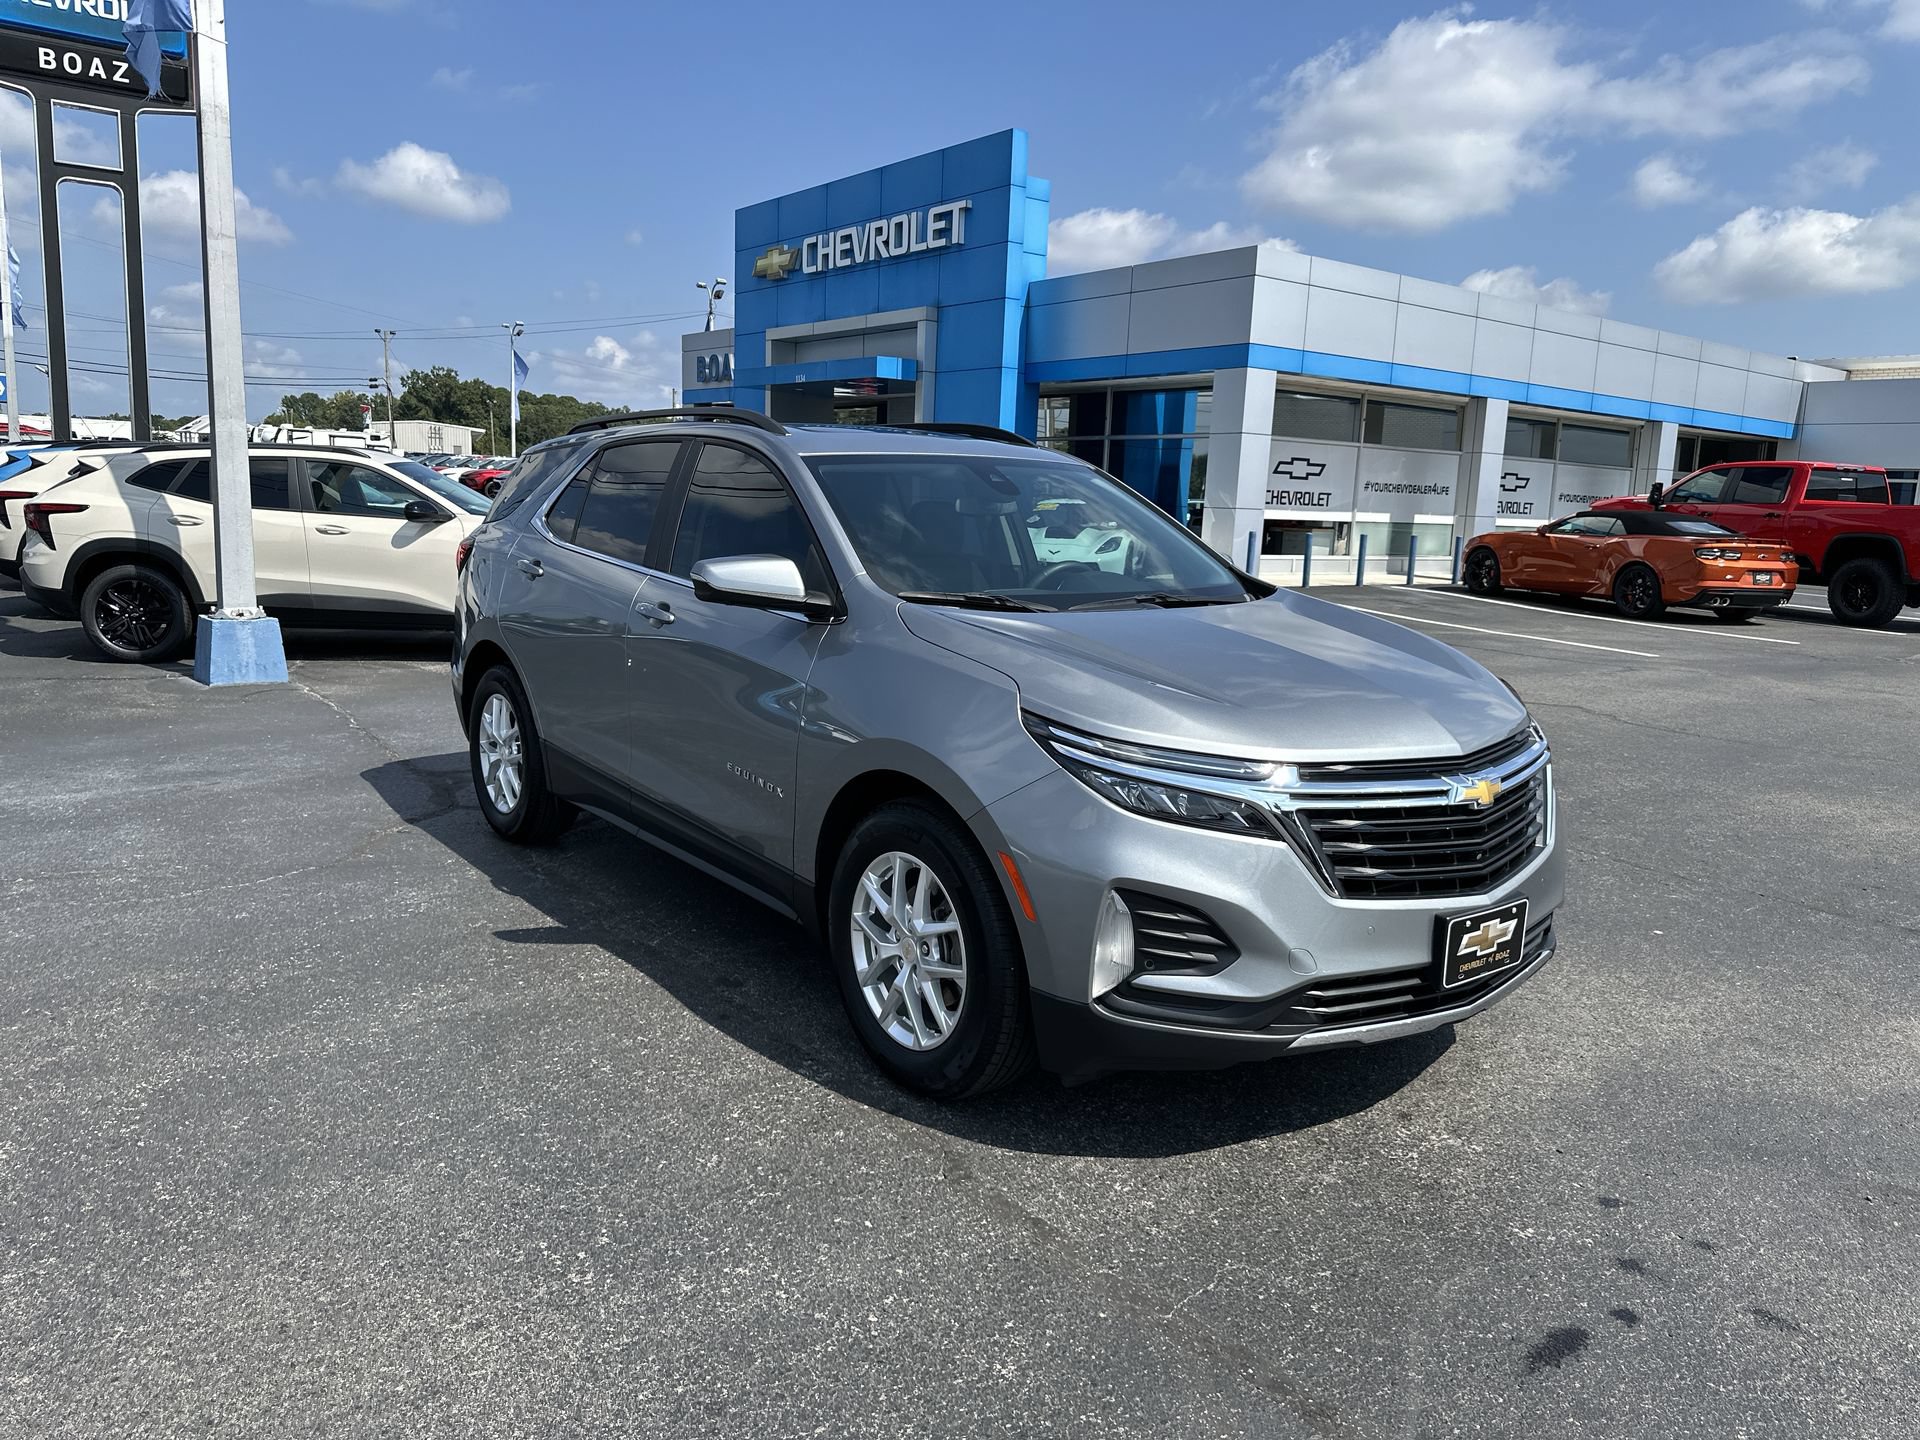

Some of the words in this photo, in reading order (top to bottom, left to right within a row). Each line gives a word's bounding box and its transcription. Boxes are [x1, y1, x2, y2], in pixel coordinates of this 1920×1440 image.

[38, 46, 130, 83] BOAZ
[802, 200, 971, 274] CHEVROLET
[1363, 480, 1450, 496] #YOURCHEVYDEALER4LIFE
[726, 761, 784, 798] EQUINOX
[1459, 957, 1487, 972] CHEVROLET
[1495, 949, 1510, 961] BOAZ
